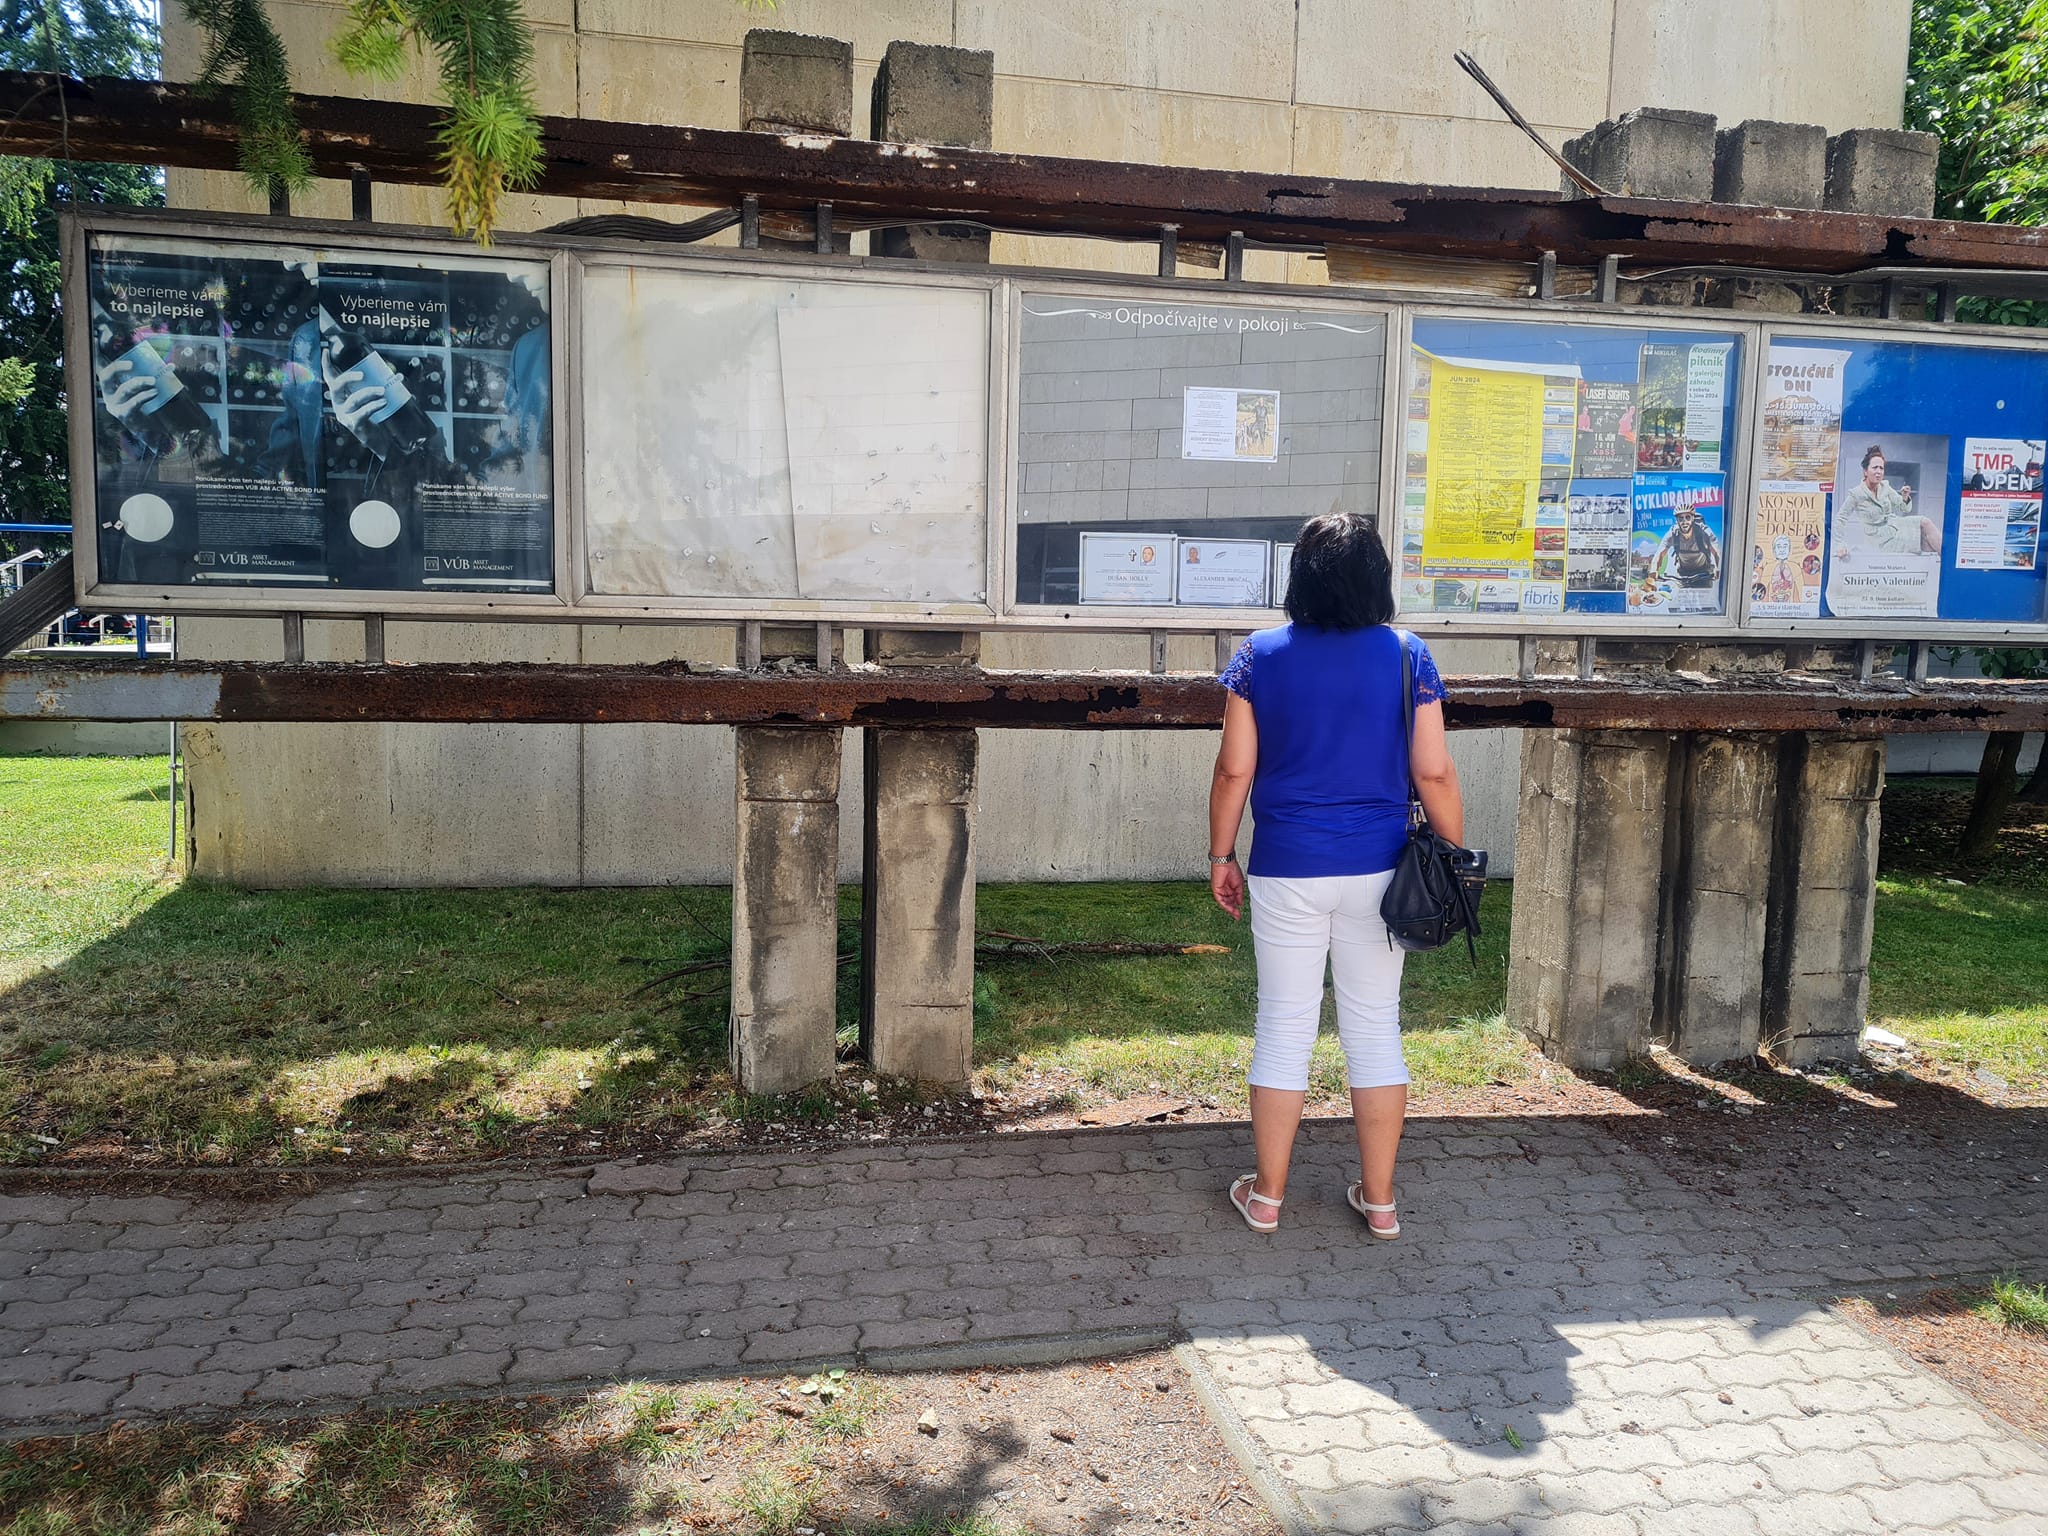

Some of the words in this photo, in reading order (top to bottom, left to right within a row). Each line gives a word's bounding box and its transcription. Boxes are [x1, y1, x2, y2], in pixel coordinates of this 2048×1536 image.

[110, 283, 188, 299] Vyberieme
[192, 288, 224, 301] vám
[110, 301, 128, 312] to
[133, 302, 205, 318] najlepšie
[340, 295, 415, 312] Vyberieme
[418, 300, 447, 312] vám
[341, 312, 358, 324] to
[362, 313, 431, 330] najlepšie
[1115, 307, 1218, 329] Odpočívajte
[1223, 317, 1234, 329] v
[1238, 316, 1289, 336] pokoji
[1690, 356, 1723, 368] piknik
[1767, 364, 1834, 379] STOLIČNÉ
[1784, 380, 1811, 392] DNI
[1586, 388, 1607, 400] LASER
[1607, 390, 1630, 401] SIGHTS
[1972, 453, 2014, 471] TMR
[196, 475, 227, 483] Ponúkame
[1981, 473, 2033, 491] OPEN
[477, 484, 499, 492] najlepší
[1635, 485, 1719, 511] CYKLORAŇAJKY
[1786, 496, 1815, 509] SOM
[1766, 522, 1786, 536] DO
[1788, 523, 1820, 537] SEBA
[219, 552, 249, 566] VÚB
[442, 556, 470, 570] VÚB
[1843, 575, 1880, 588] Shirley
[1881, 575, 1926, 587] Valentine
[1523, 588, 1559, 605] fibris
